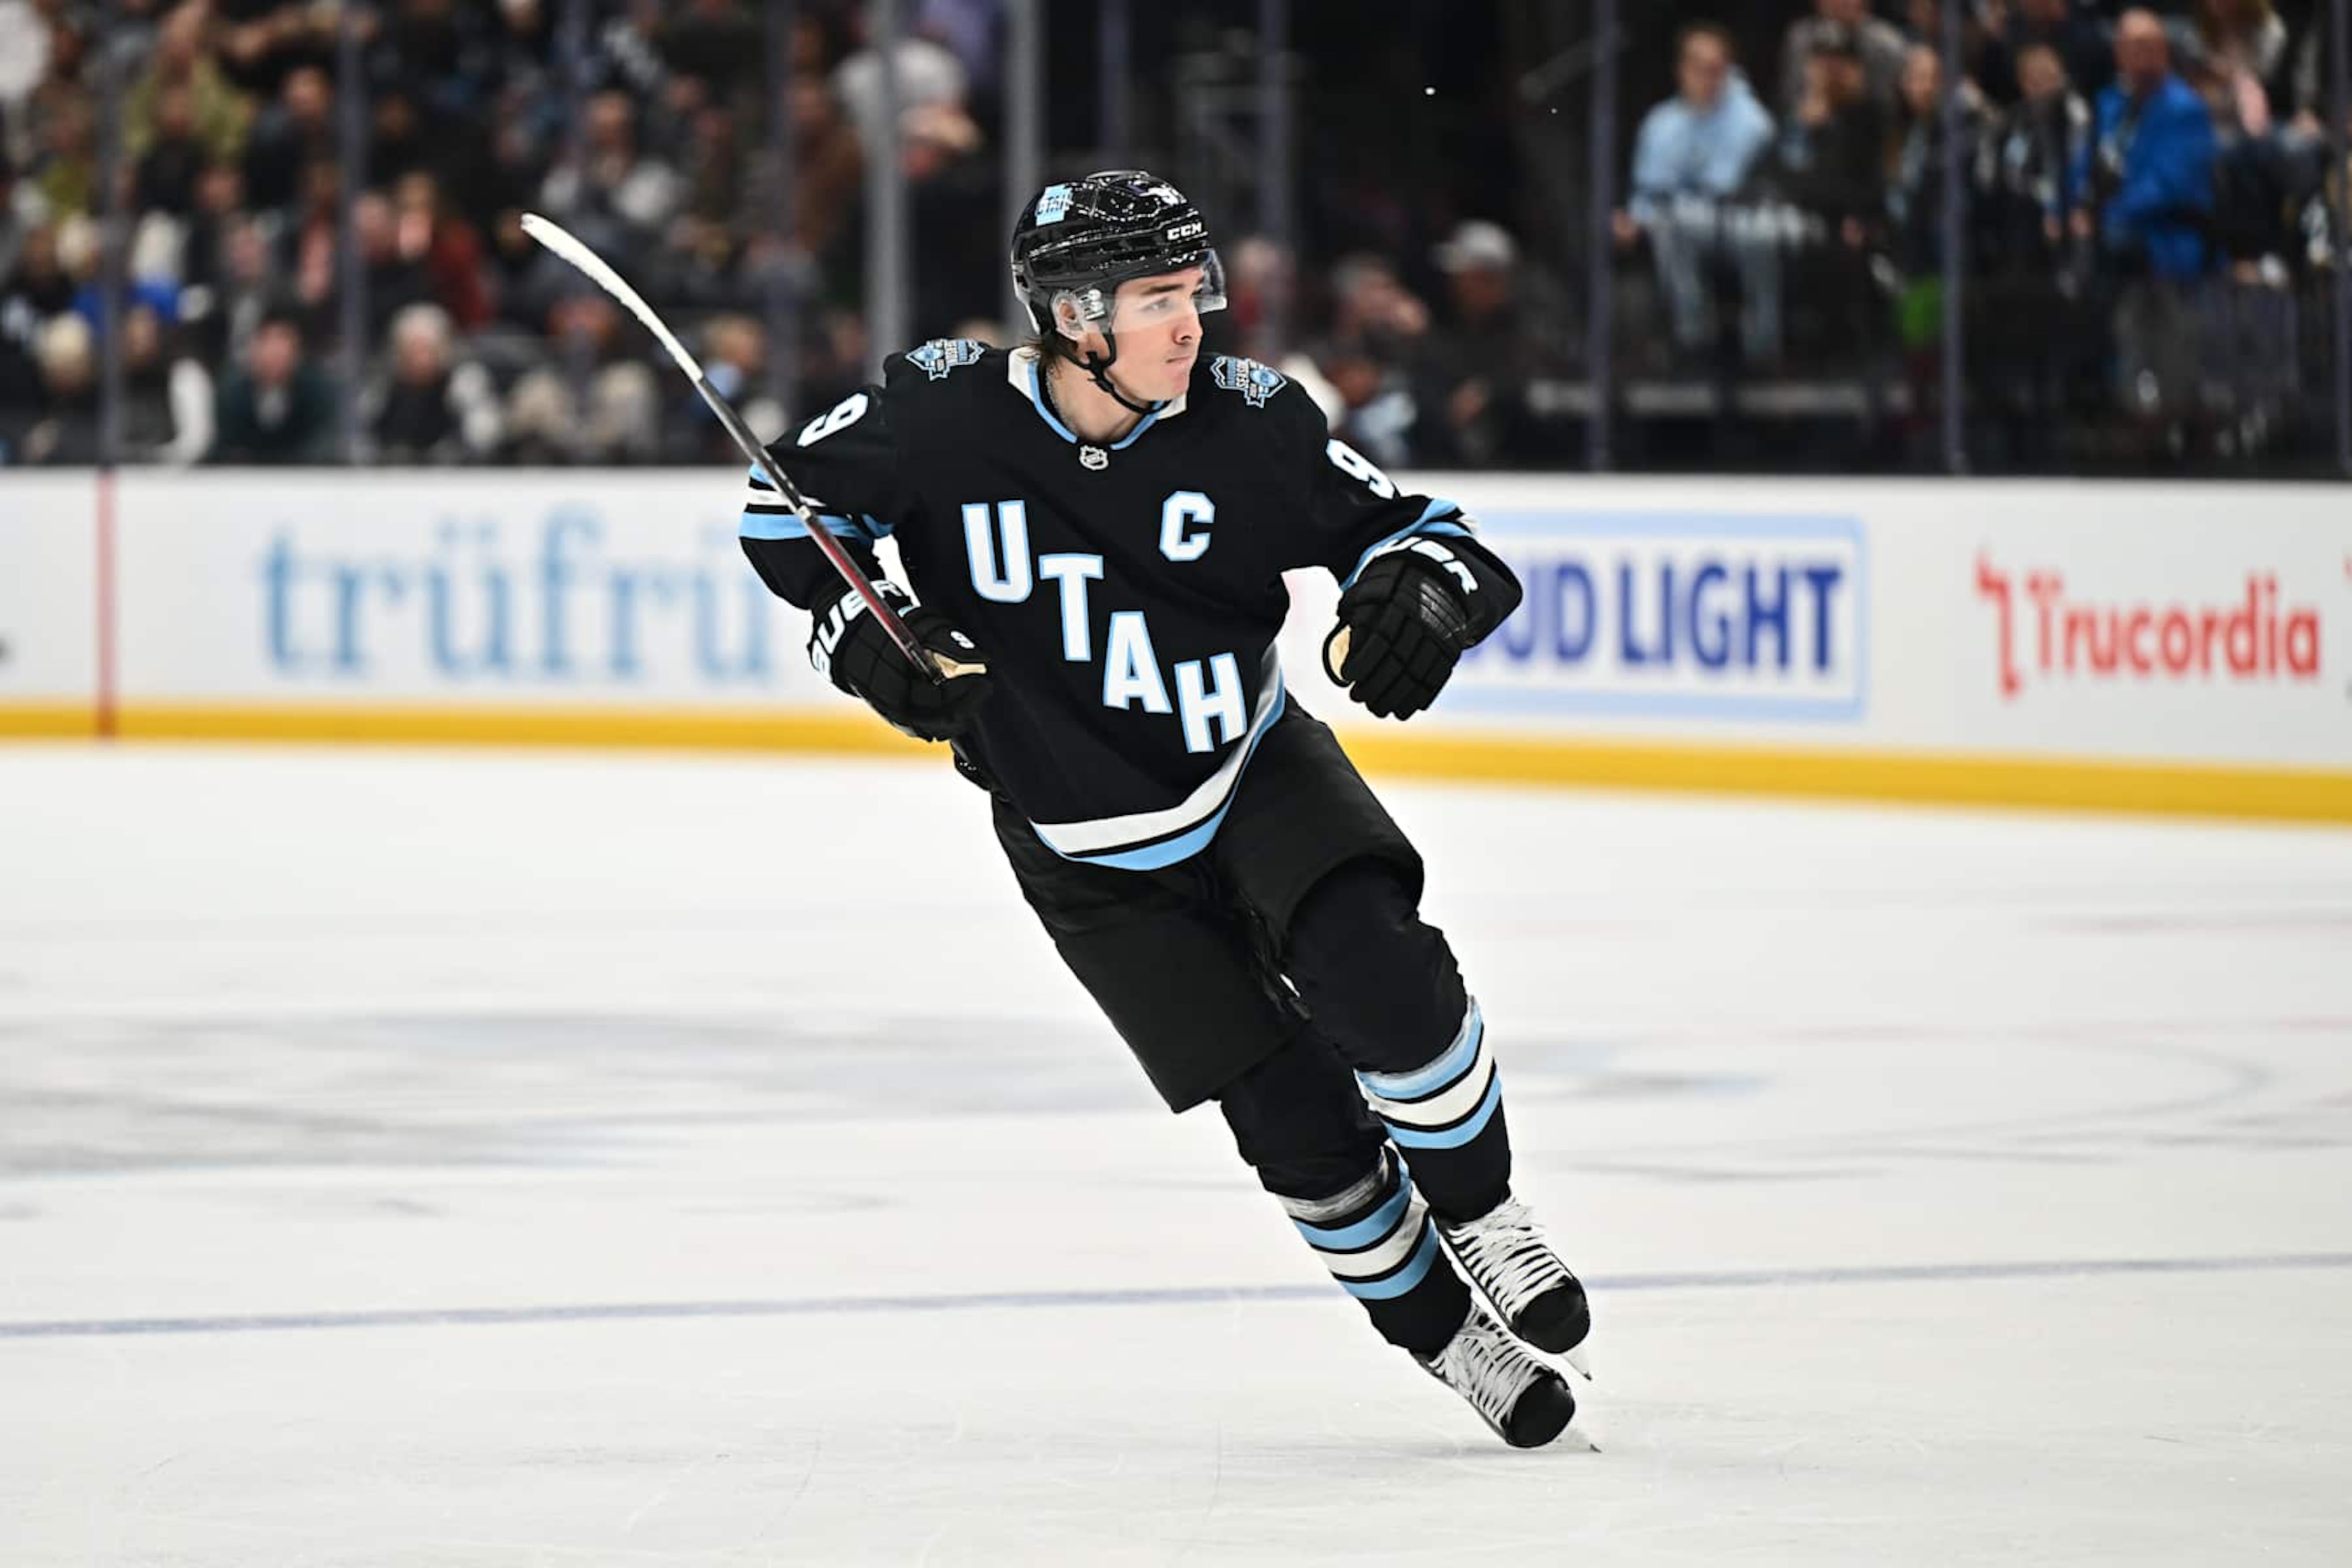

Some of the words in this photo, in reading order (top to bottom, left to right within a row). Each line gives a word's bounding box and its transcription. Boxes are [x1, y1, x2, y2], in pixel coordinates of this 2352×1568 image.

[1167, 221, 1202, 241] CCM
[797, 392, 869, 448] 9
[1325, 438, 1396, 500] 9
[1159, 490, 1216, 562] C
[260, 505, 774, 677] trüfrü
[960, 499, 1248, 754] UTAH
[1463, 559, 1596, 664] UD
[1618, 559, 1841, 671] LIGHT
[2026, 568, 2321, 676] Trucordia
